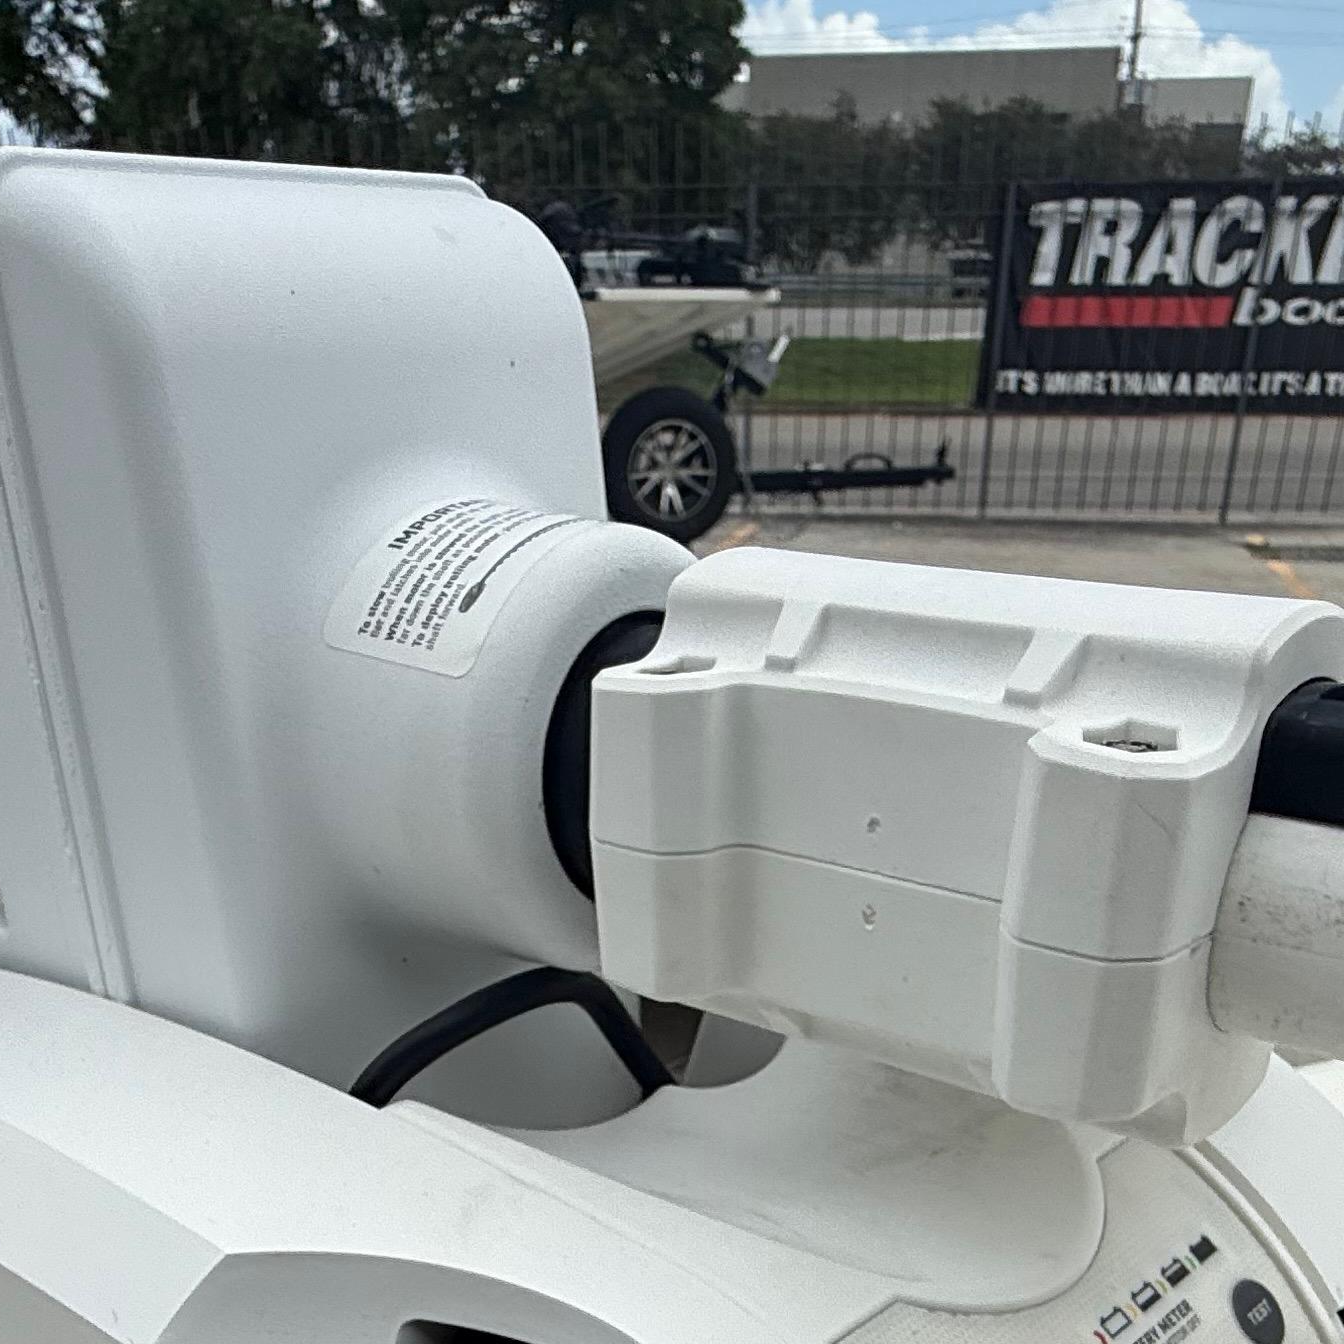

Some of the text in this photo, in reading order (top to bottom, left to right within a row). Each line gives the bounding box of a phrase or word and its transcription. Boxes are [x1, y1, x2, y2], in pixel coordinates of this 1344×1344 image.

[384, 606, 409, 641] When
[403, 573, 429, 605] motor
[411, 632, 425, 648] To
[421, 591, 449, 631] deploy
[358, 620, 371, 635] To
[1158, 1299, 1193, 1335] METER
[1247, 1297, 1272, 1326] TEST
